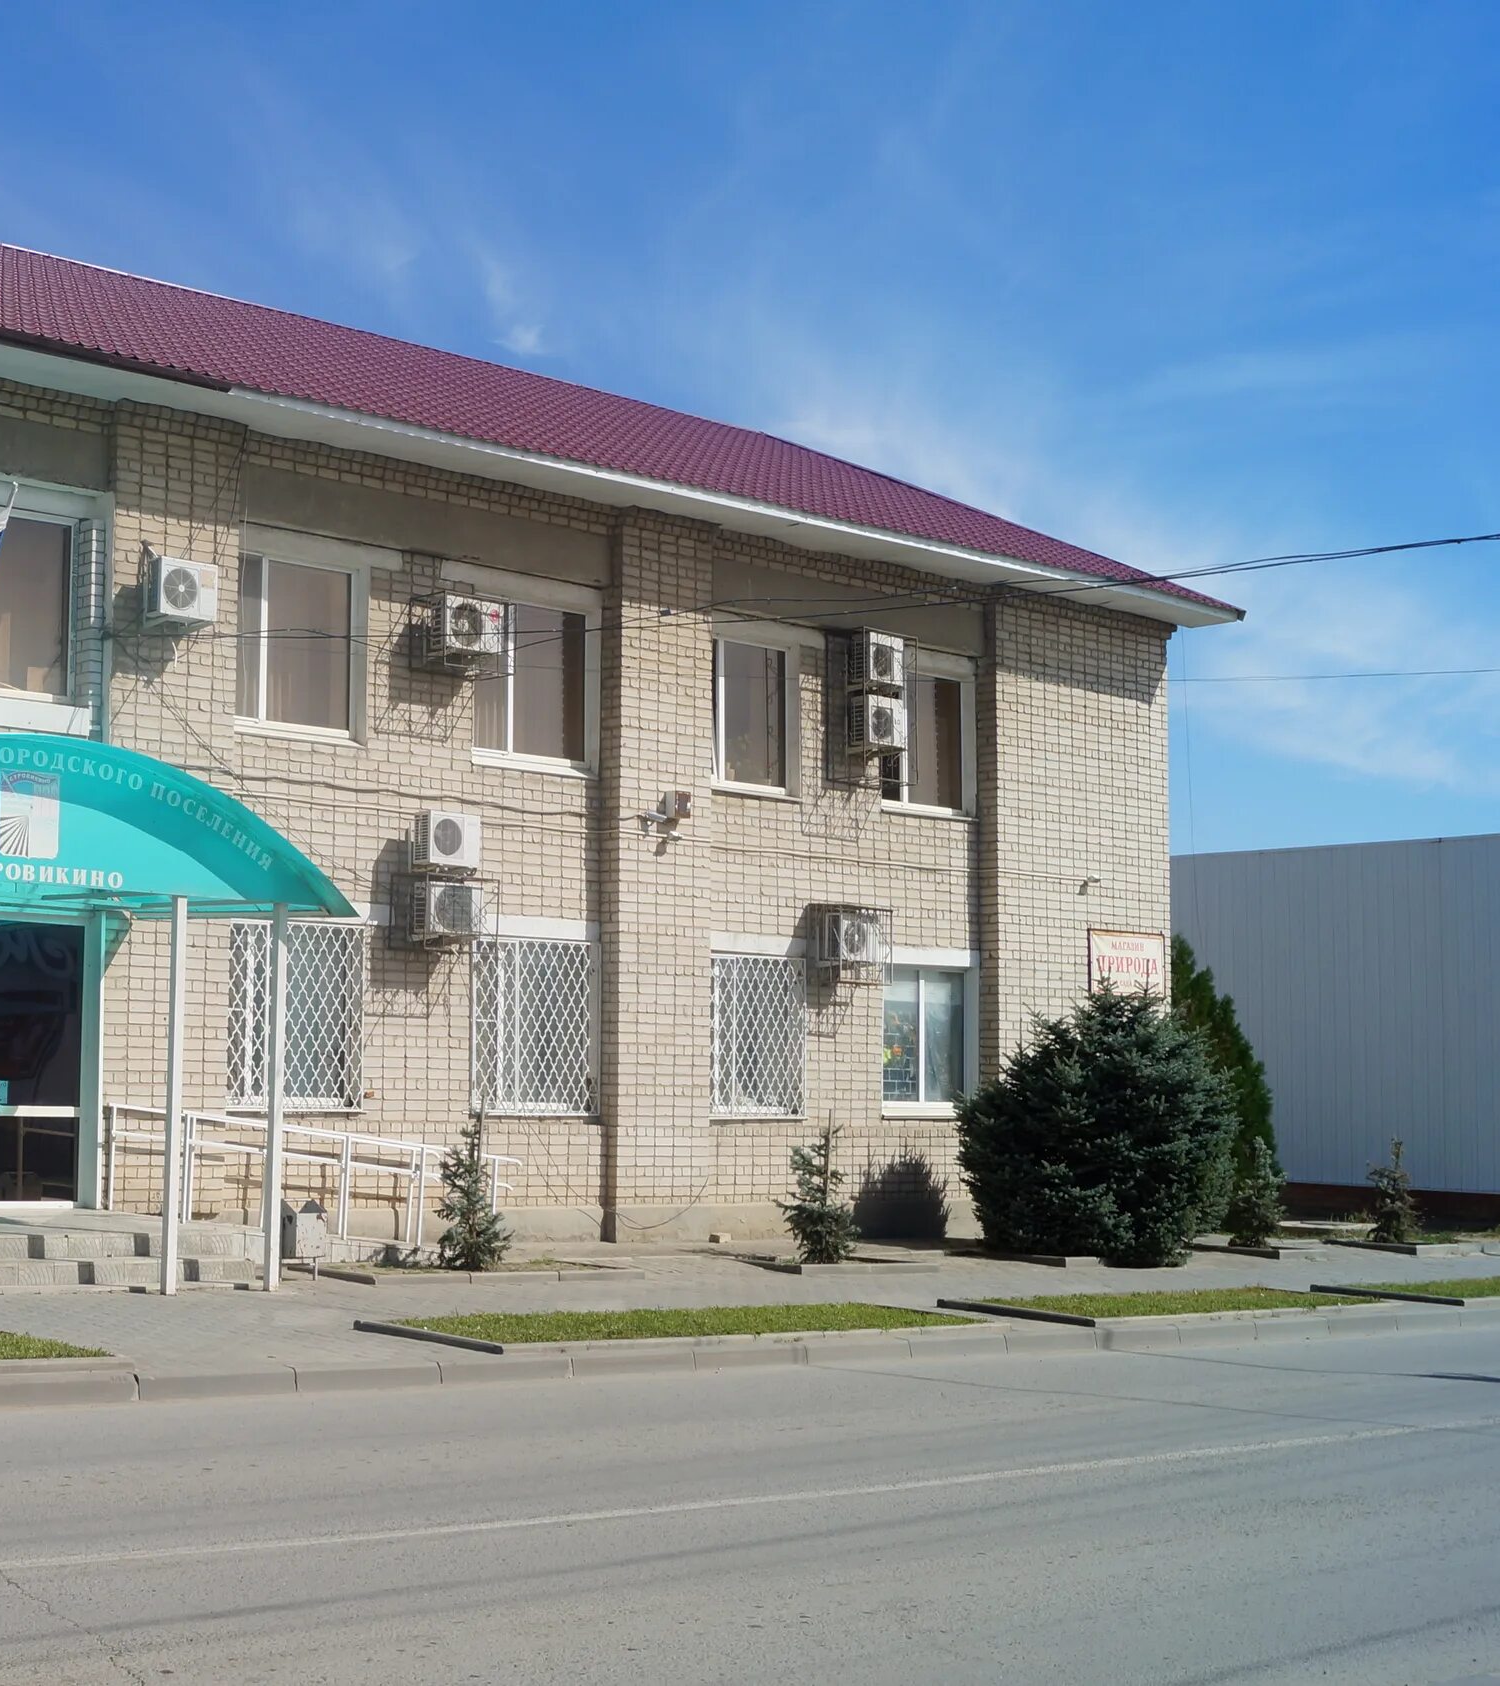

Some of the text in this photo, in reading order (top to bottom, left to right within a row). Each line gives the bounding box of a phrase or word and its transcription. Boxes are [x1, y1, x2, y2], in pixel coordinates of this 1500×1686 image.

[150, 781, 273, 872] ПОСЕЛЕНИЯ
[1111, 941, 1145, 952] МАГАЗИН
[1097, 955, 1158, 978] ПРИРОДА
